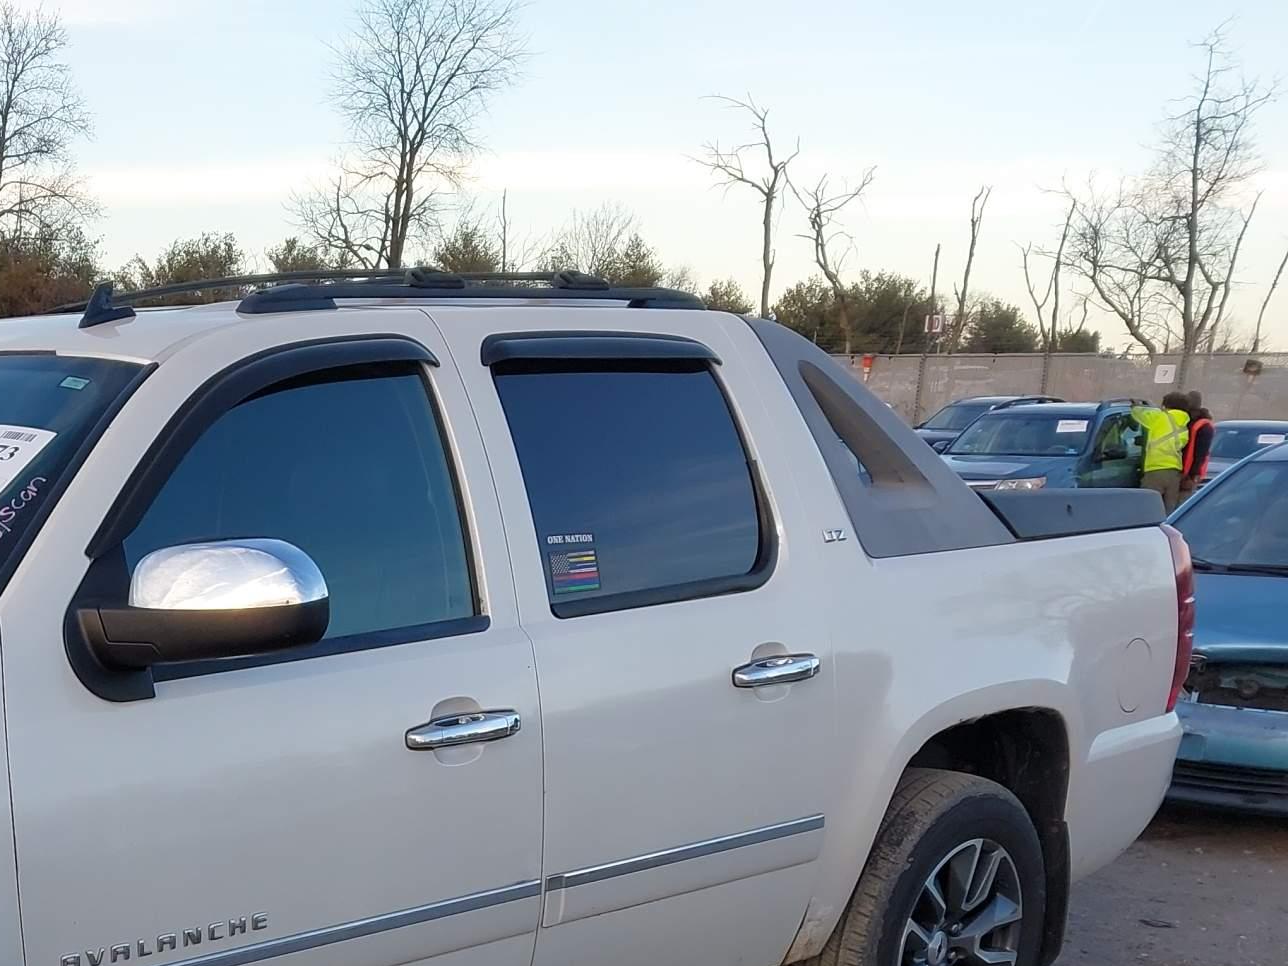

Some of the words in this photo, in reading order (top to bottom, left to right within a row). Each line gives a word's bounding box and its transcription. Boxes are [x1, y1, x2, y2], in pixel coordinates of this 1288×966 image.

[547, 535, 564, 544] ONE
[565, 534, 593, 543] NATION
[822, 529, 847, 543] LTZ
